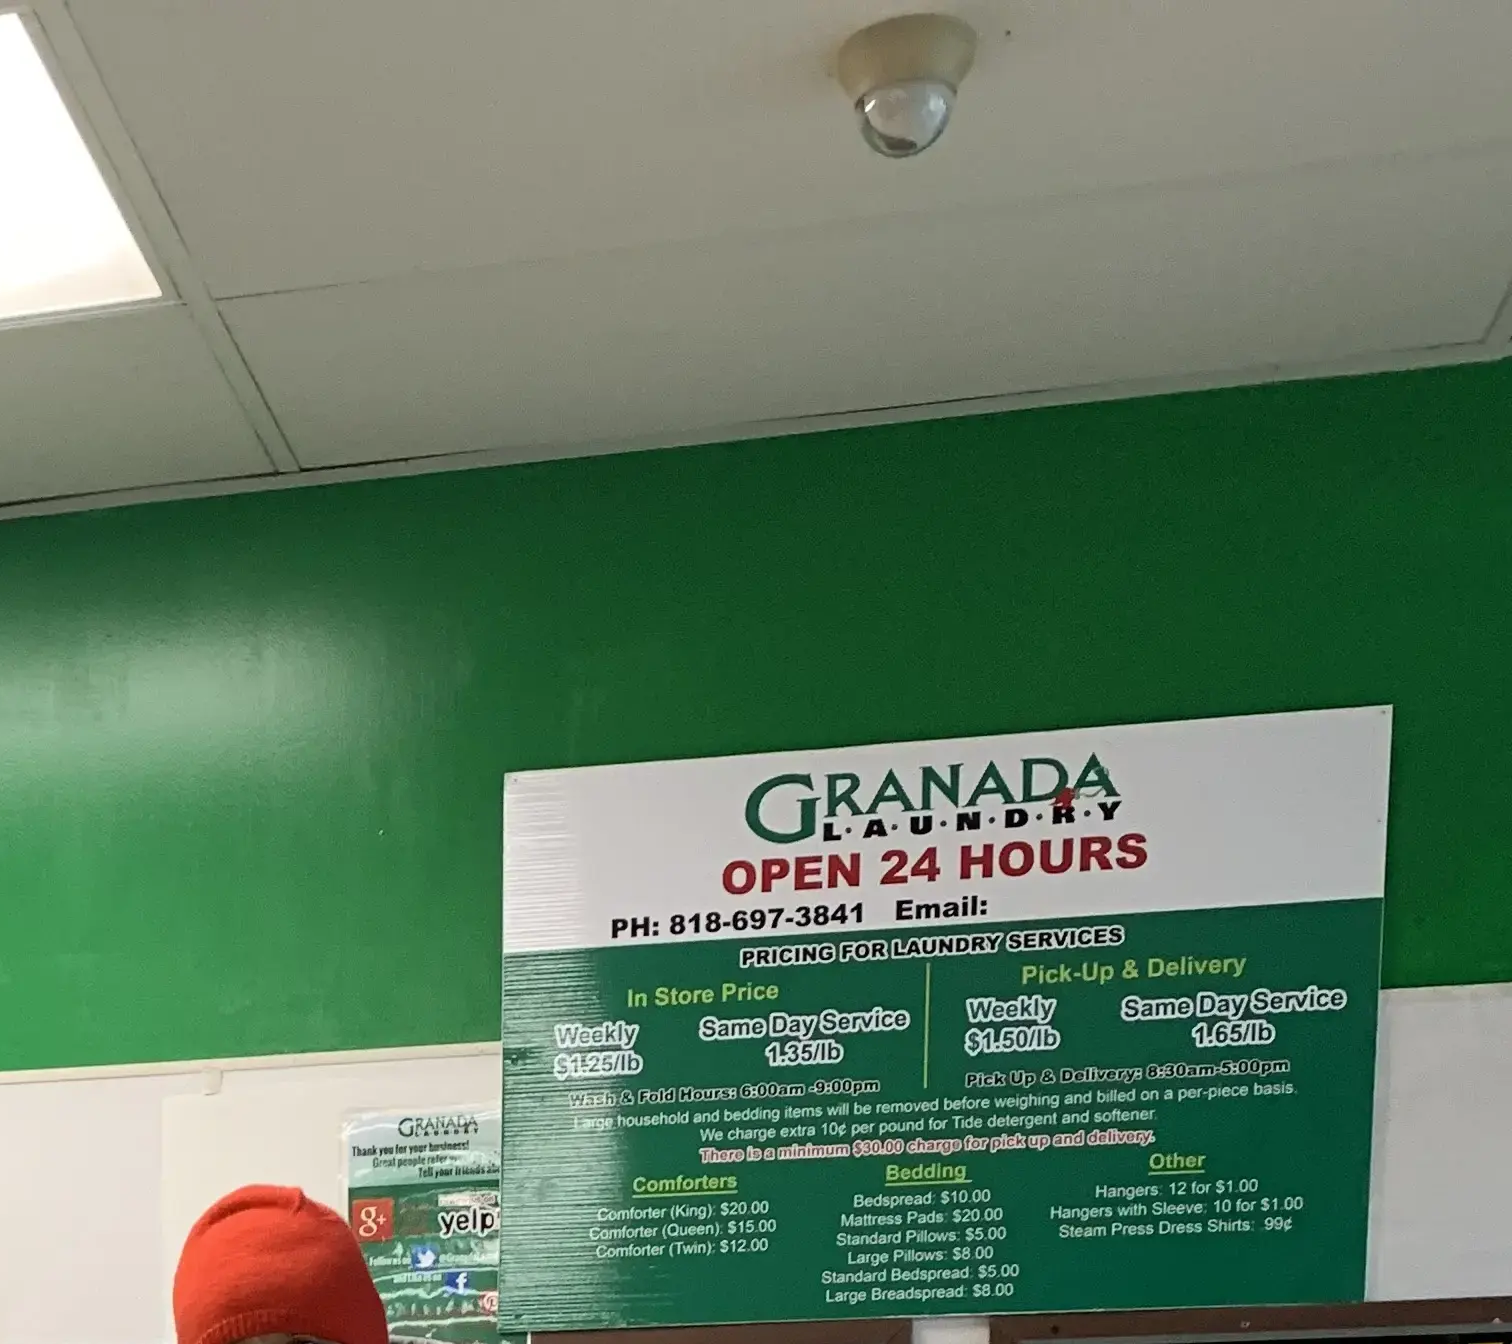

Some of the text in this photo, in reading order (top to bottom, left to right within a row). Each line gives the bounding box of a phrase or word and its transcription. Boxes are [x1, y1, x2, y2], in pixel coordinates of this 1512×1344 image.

[745, 752, 1121, 844] GRANADA
[722, 832, 1148, 895] OPEN 24 HOURS
[611, 895, 988, 938] PH: 818-697-3841 Email:
[741, 926, 1124, 967] PRICING FOR LAUNDRY SERVICES
[1022, 956, 1246, 985] Pick-Up & Delivery
[627, 982, 779, 1008] In Store Price
[1122, 986, 1346, 1020] Same Day Service
[967, 995, 1056, 1023] Weekly
[556, 1022, 639, 1048] Weekly
[700, 1008, 909, 1040] Same Day Service
[1192, 1020, 1275, 1047] 1.65/lb
[766, 1040, 843, 1066] 1.35/lb
[965, 1026, 1060, 1053] $1.50/lb
[966, 1059, 1289, 1087] Pick Up & Delivery: 8:30am-5:00pm
[621, 1091, 633, 1104] &
[639, 1089, 674, 1103] Fold
[680, 1088, 736, 1101] Hours:
[741, 1084, 804, 1097] 6:00am
[811, 1080, 879, 1095] -9:00pm
[885, 1165, 966, 1183] Bedding
[1149, 1153, 1206, 1171] Other
[633, 1175, 738, 1193] Comforters
[1095, 1178, 1258, 1199] Hangers: 12 for $1.00
[440, 1207, 496, 1237] yelp
[1050, 1196, 1304, 1221] Hangers with Sleeve: 10 for $1.00
[1059, 1217, 1292, 1238] Steam Press Dress Shirts: 99¢
